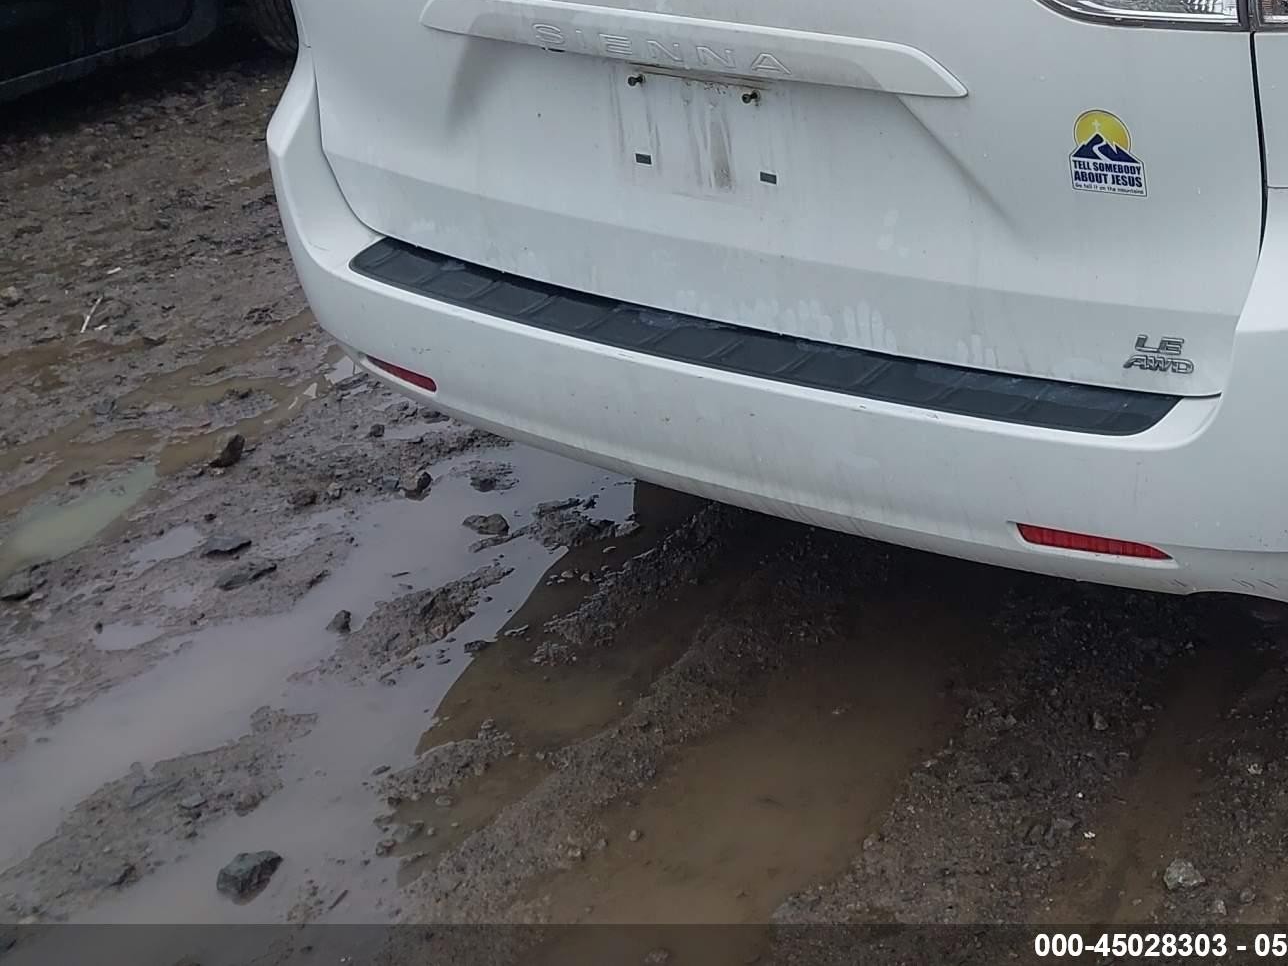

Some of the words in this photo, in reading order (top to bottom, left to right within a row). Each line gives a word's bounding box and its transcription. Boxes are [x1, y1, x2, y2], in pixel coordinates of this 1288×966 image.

[531, 22, 792, 76] SIENNA
[1072, 160, 1091, 170] TELL
[1093, 162, 1141, 175] SOMEBODY
[1074, 171, 1108, 184] ABOUT
[1111, 174, 1142, 187] JESUS
[1135, 334, 1184, 355] LE
[1123, 355, 1194, 374] AWD
